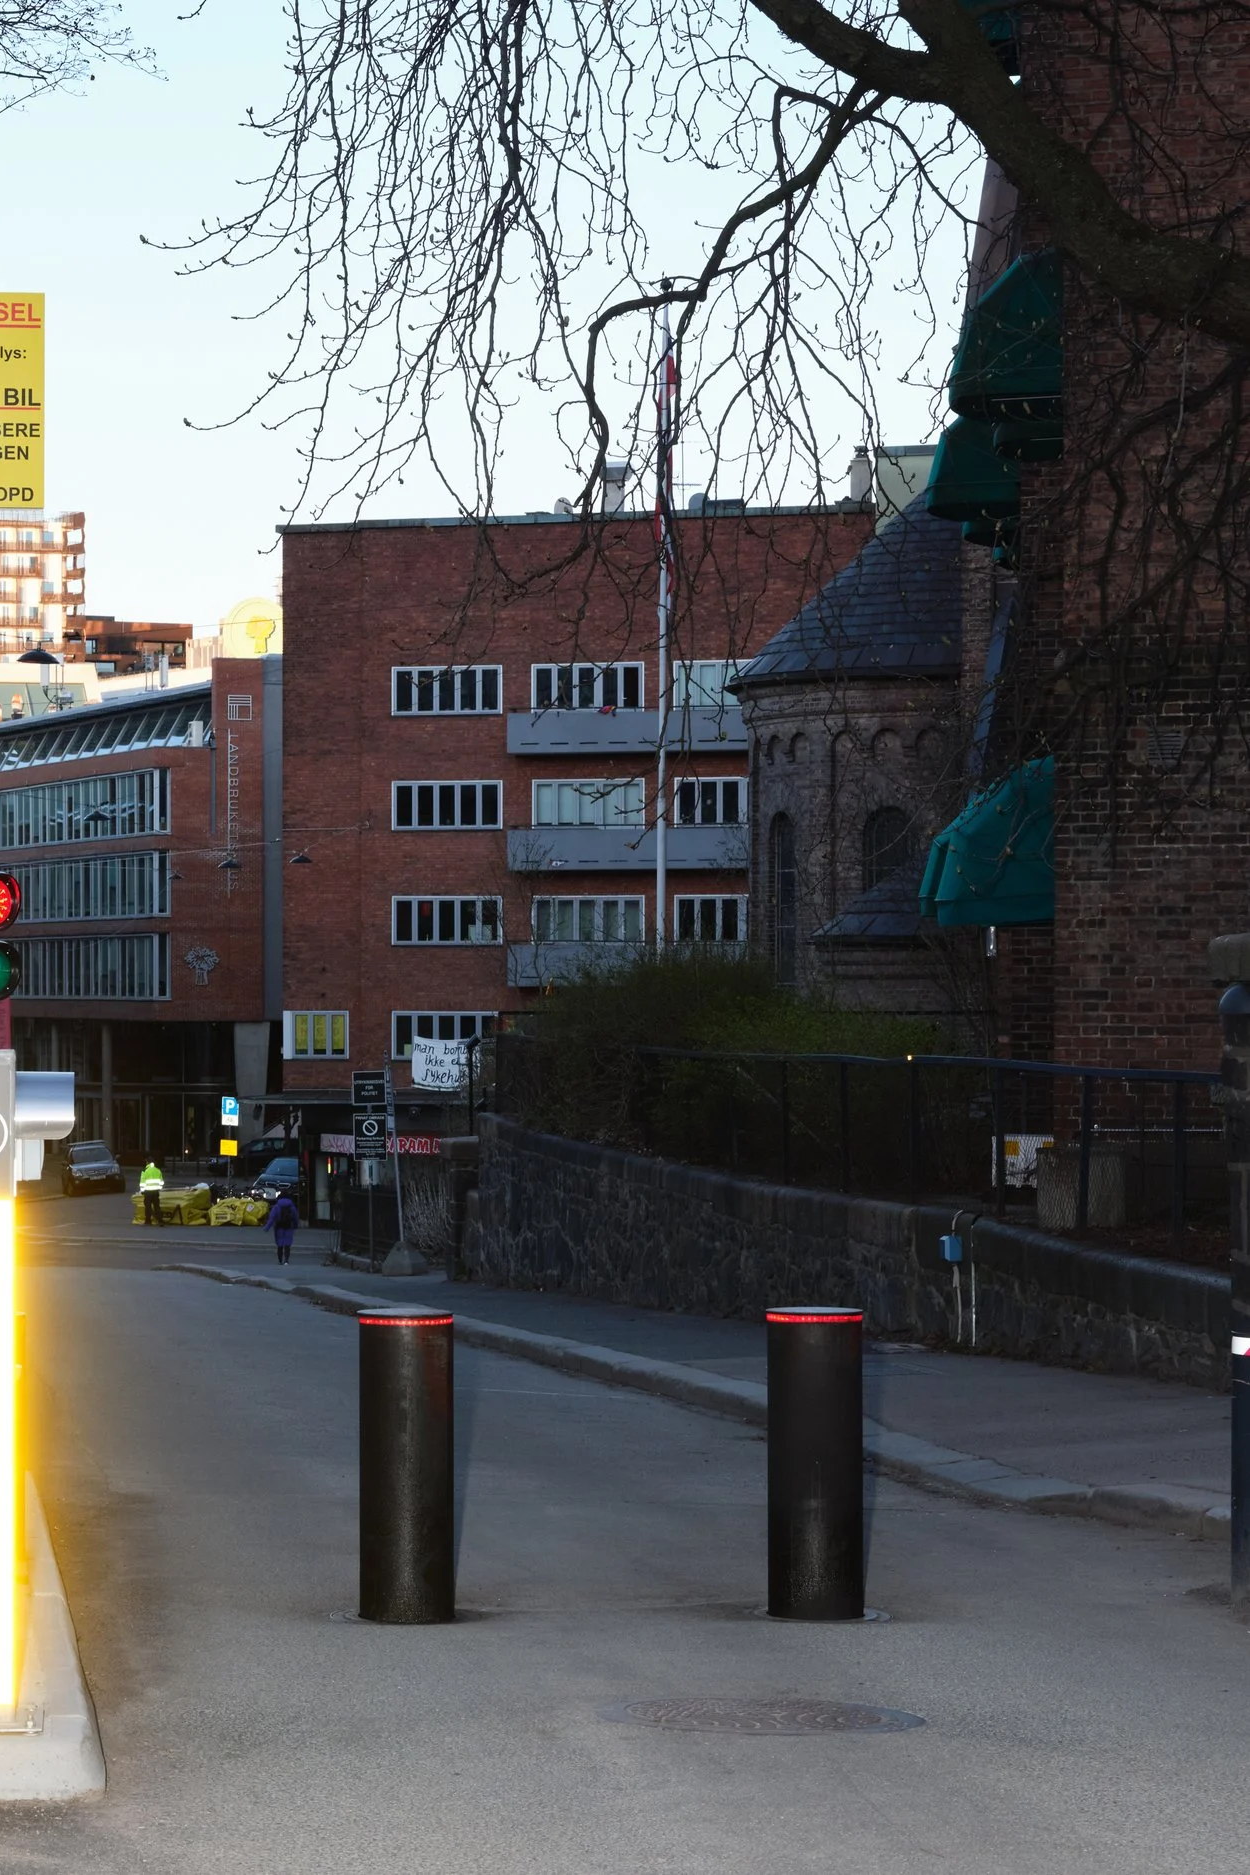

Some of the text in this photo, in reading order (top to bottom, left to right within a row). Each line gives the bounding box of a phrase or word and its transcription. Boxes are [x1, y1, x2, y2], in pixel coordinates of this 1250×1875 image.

[0, 346, 27, 362] lys:
[4, 388, 41, 407] BIL
[414, 1043, 435, 1055] man
[424, 1055, 445, 1067] ikke
[225, 1099, 235, 1114] P
